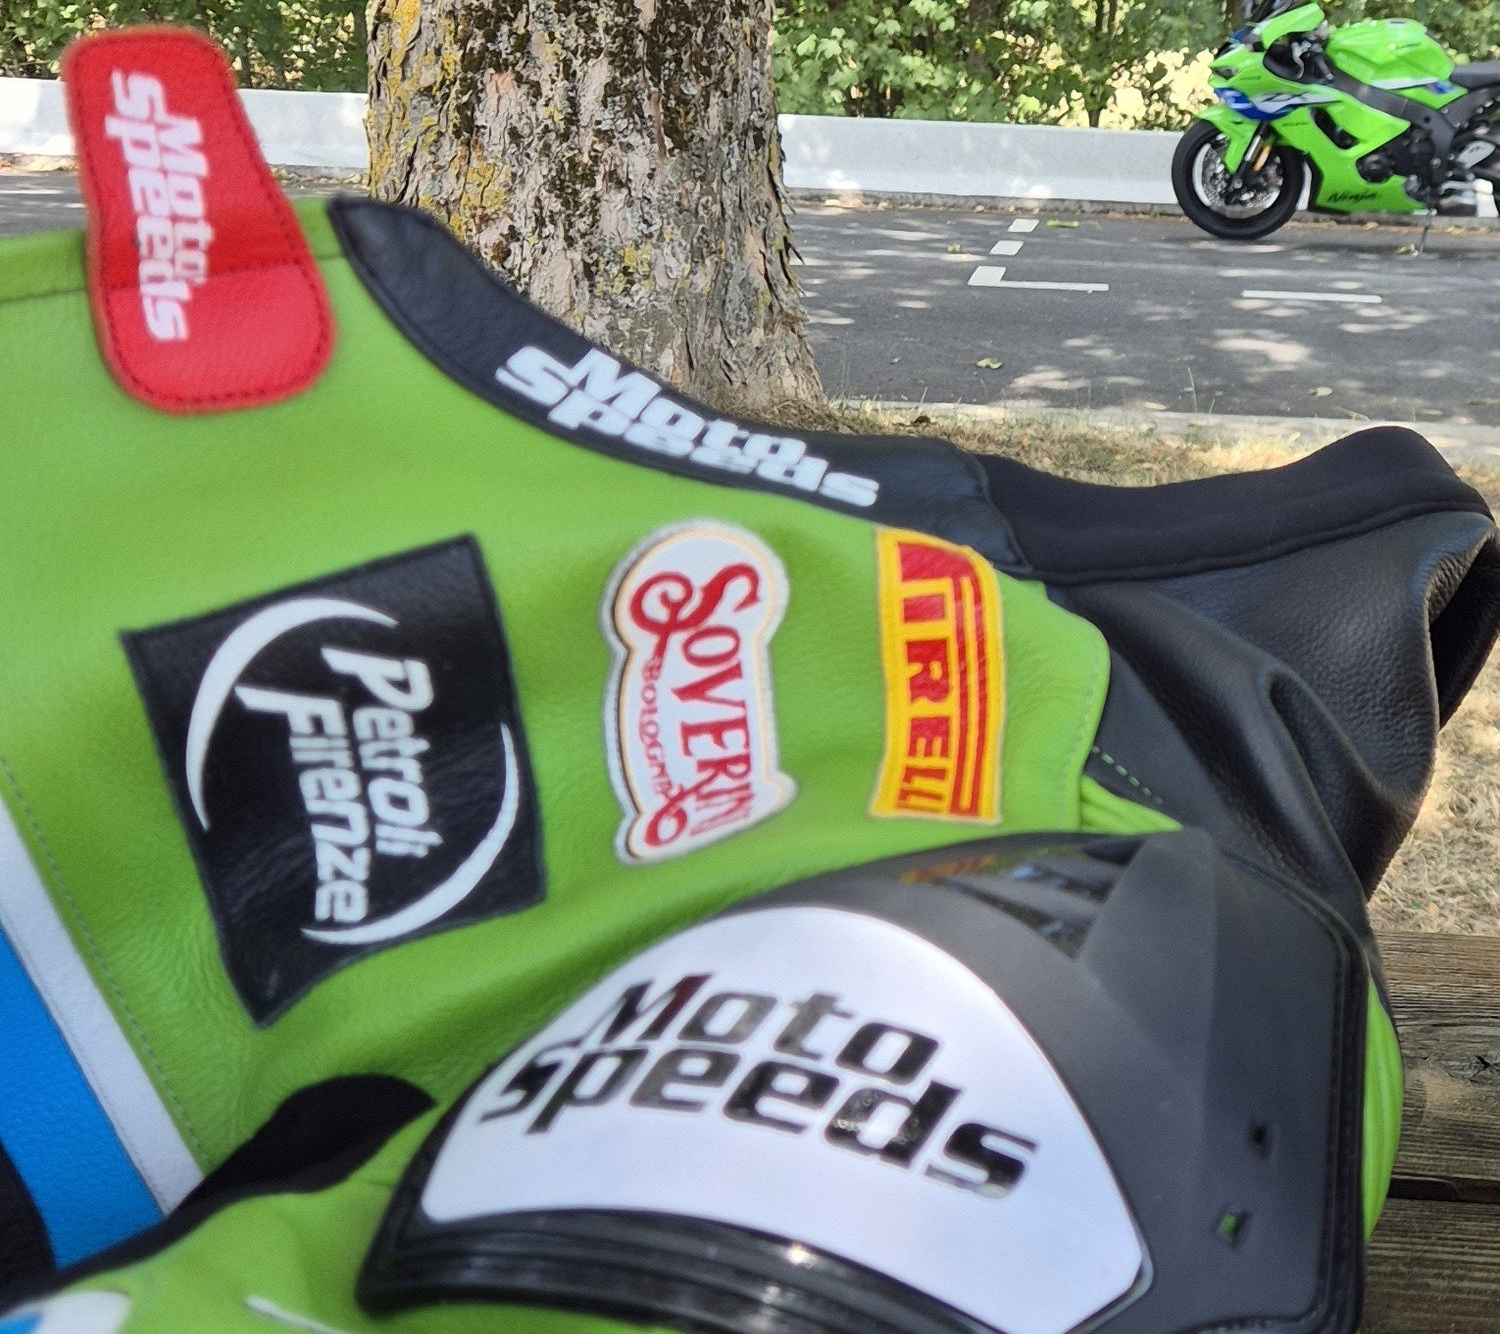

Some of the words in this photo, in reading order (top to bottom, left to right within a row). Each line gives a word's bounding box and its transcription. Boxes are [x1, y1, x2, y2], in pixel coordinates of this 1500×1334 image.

[154, 114, 215, 285] Moto
[1327, 190, 1379, 205] Ninja
[560, 347, 808, 466] Moto
[234, 684, 372, 923] Firenze
[320, 646, 445, 859] Petroli
[585, 972, 940, 1087] Moto
